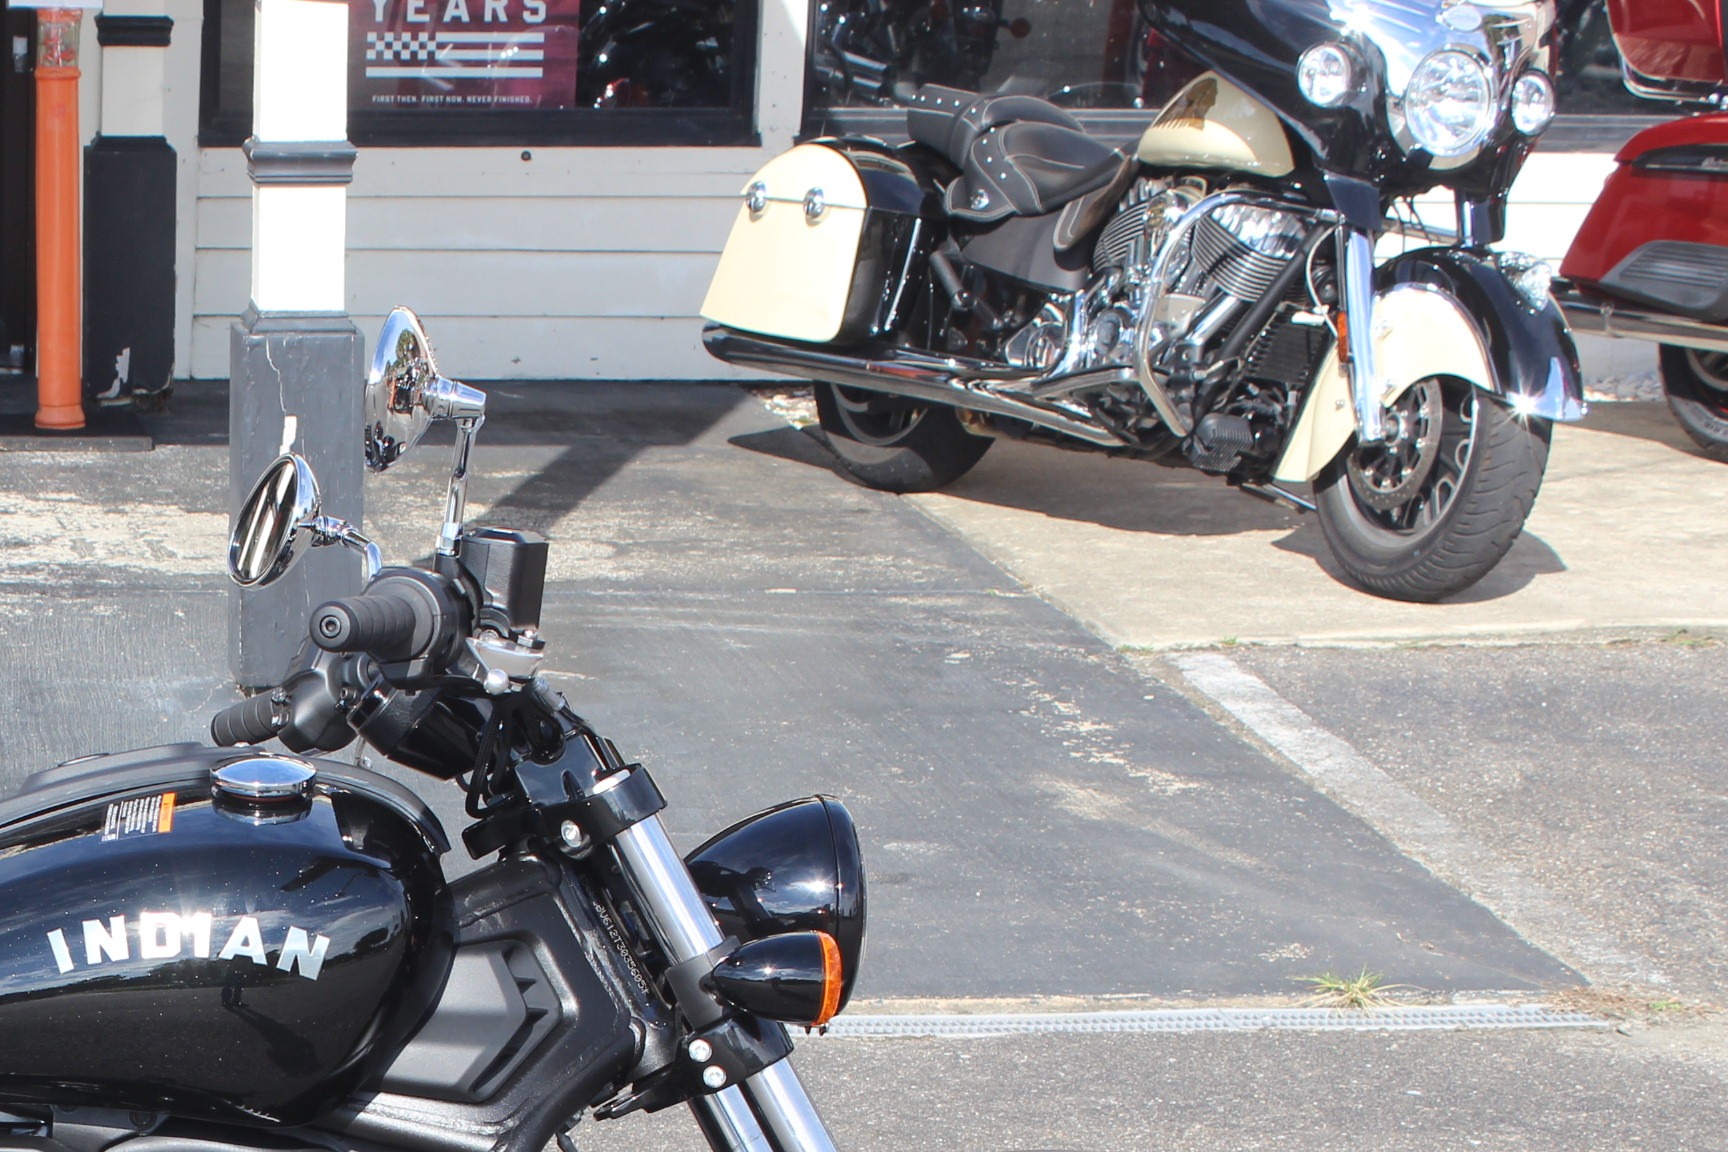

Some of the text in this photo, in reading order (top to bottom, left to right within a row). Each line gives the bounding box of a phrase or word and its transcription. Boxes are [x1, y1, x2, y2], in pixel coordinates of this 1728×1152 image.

[373, 0, 547, 23] YEARS
[372, 95, 394, 103] FIRST
[422, 95, 444, 103] FIRST
[467, 95, 492, 103] NEVER
[46, 911, 331, 982] INDIAN
